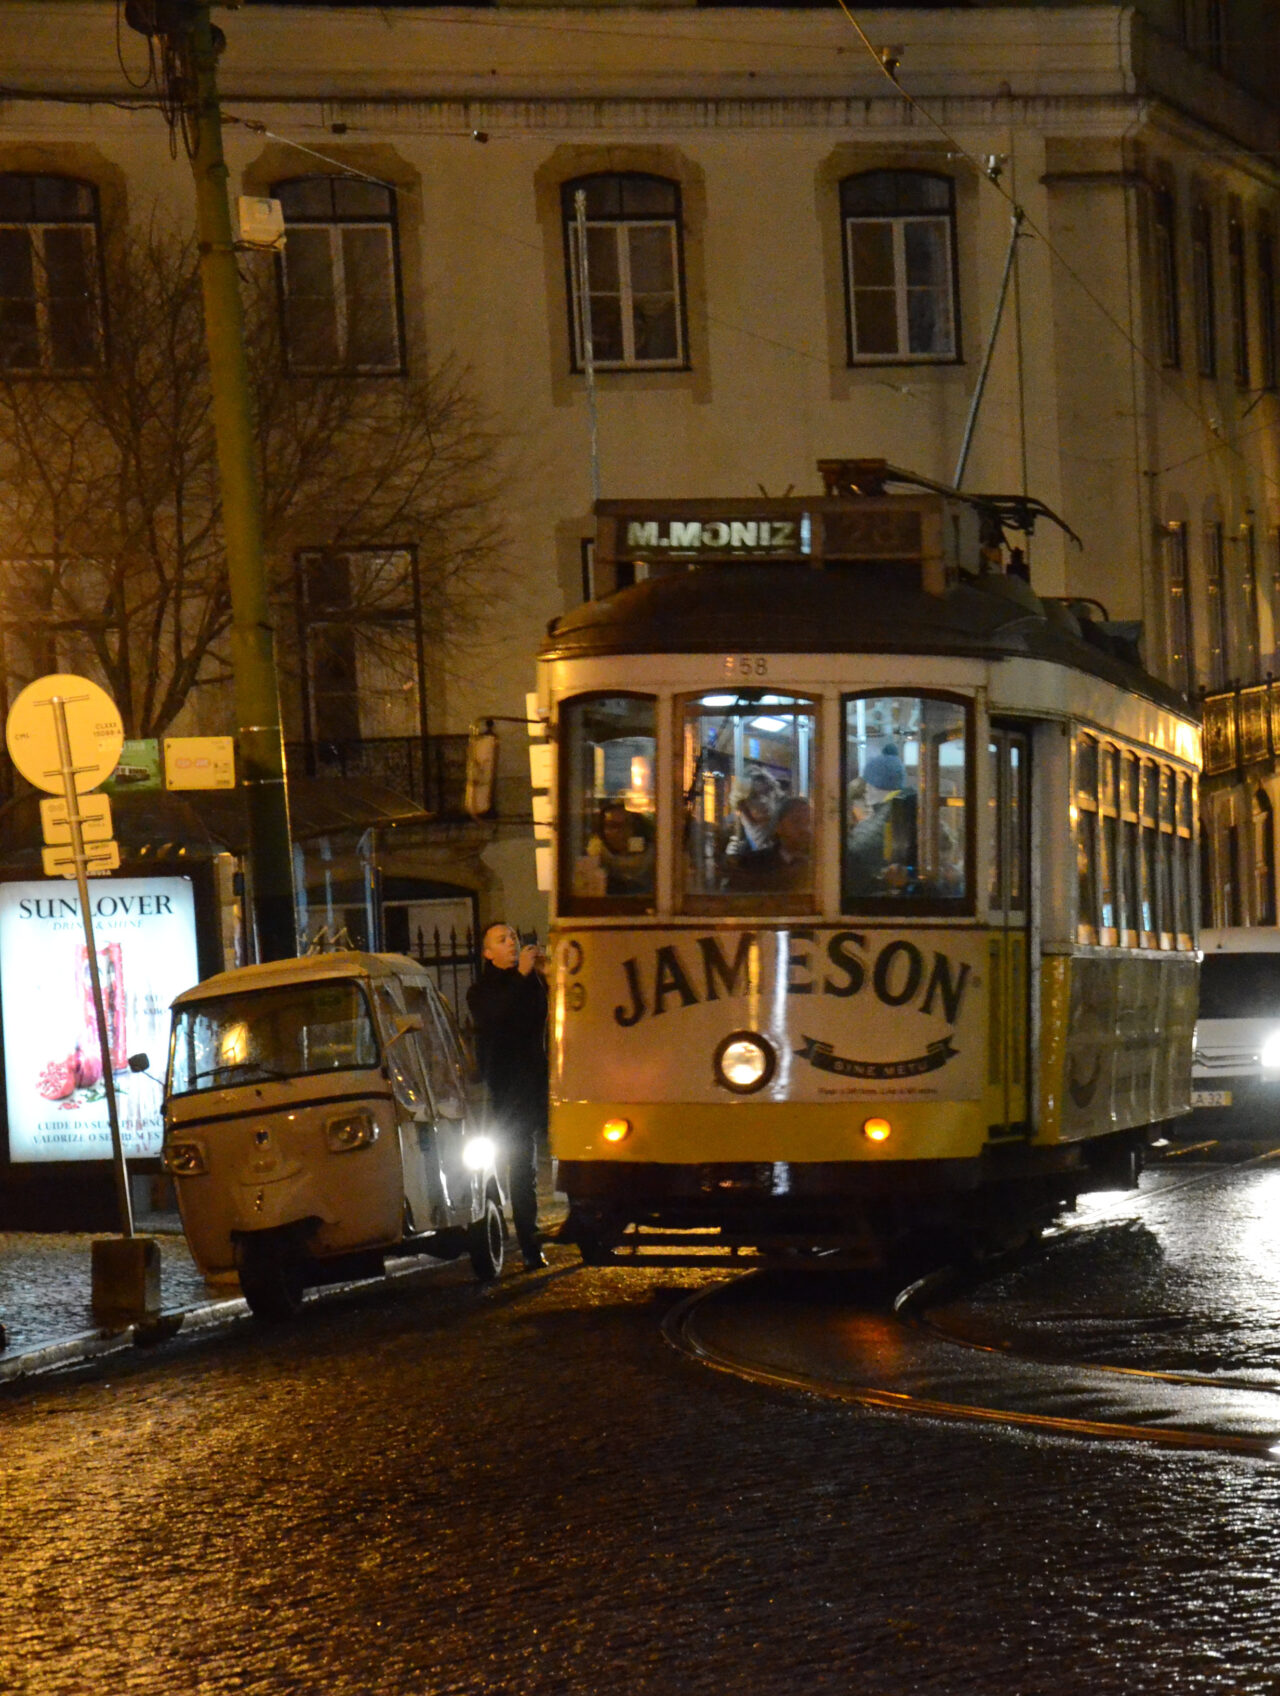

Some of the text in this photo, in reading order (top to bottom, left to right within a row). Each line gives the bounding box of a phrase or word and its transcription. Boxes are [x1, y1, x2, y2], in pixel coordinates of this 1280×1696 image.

[627, 520, 797, 548] M.MONIZ
[19, 895, 173, 919] SUNOVER
[613, 931, 971, 1028] JAMESON
